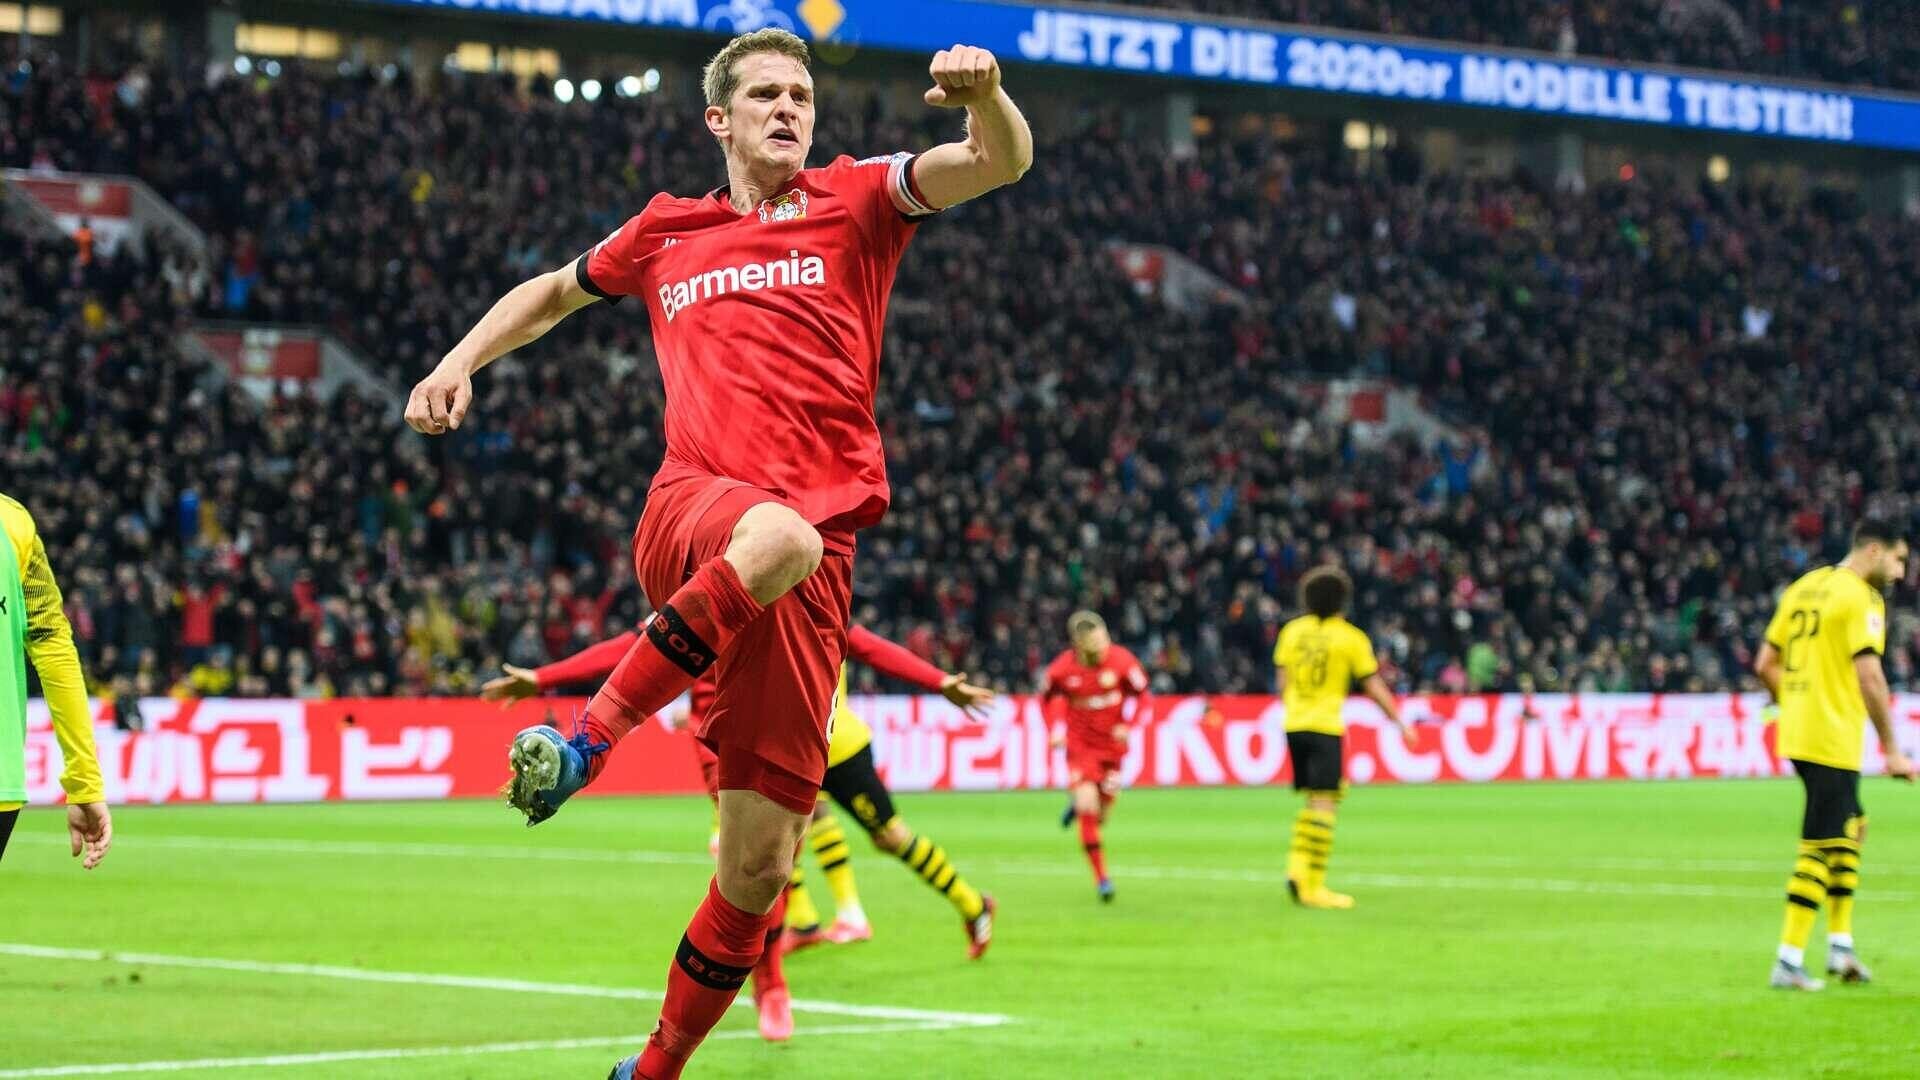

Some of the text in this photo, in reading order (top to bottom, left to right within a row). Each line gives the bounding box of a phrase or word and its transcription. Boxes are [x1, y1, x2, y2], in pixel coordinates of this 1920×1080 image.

[1018, 11, 1853, 140] JETZT DIE 2020er MODELLE TESTEN!
[659, 250, 826, 323] Barmenia
